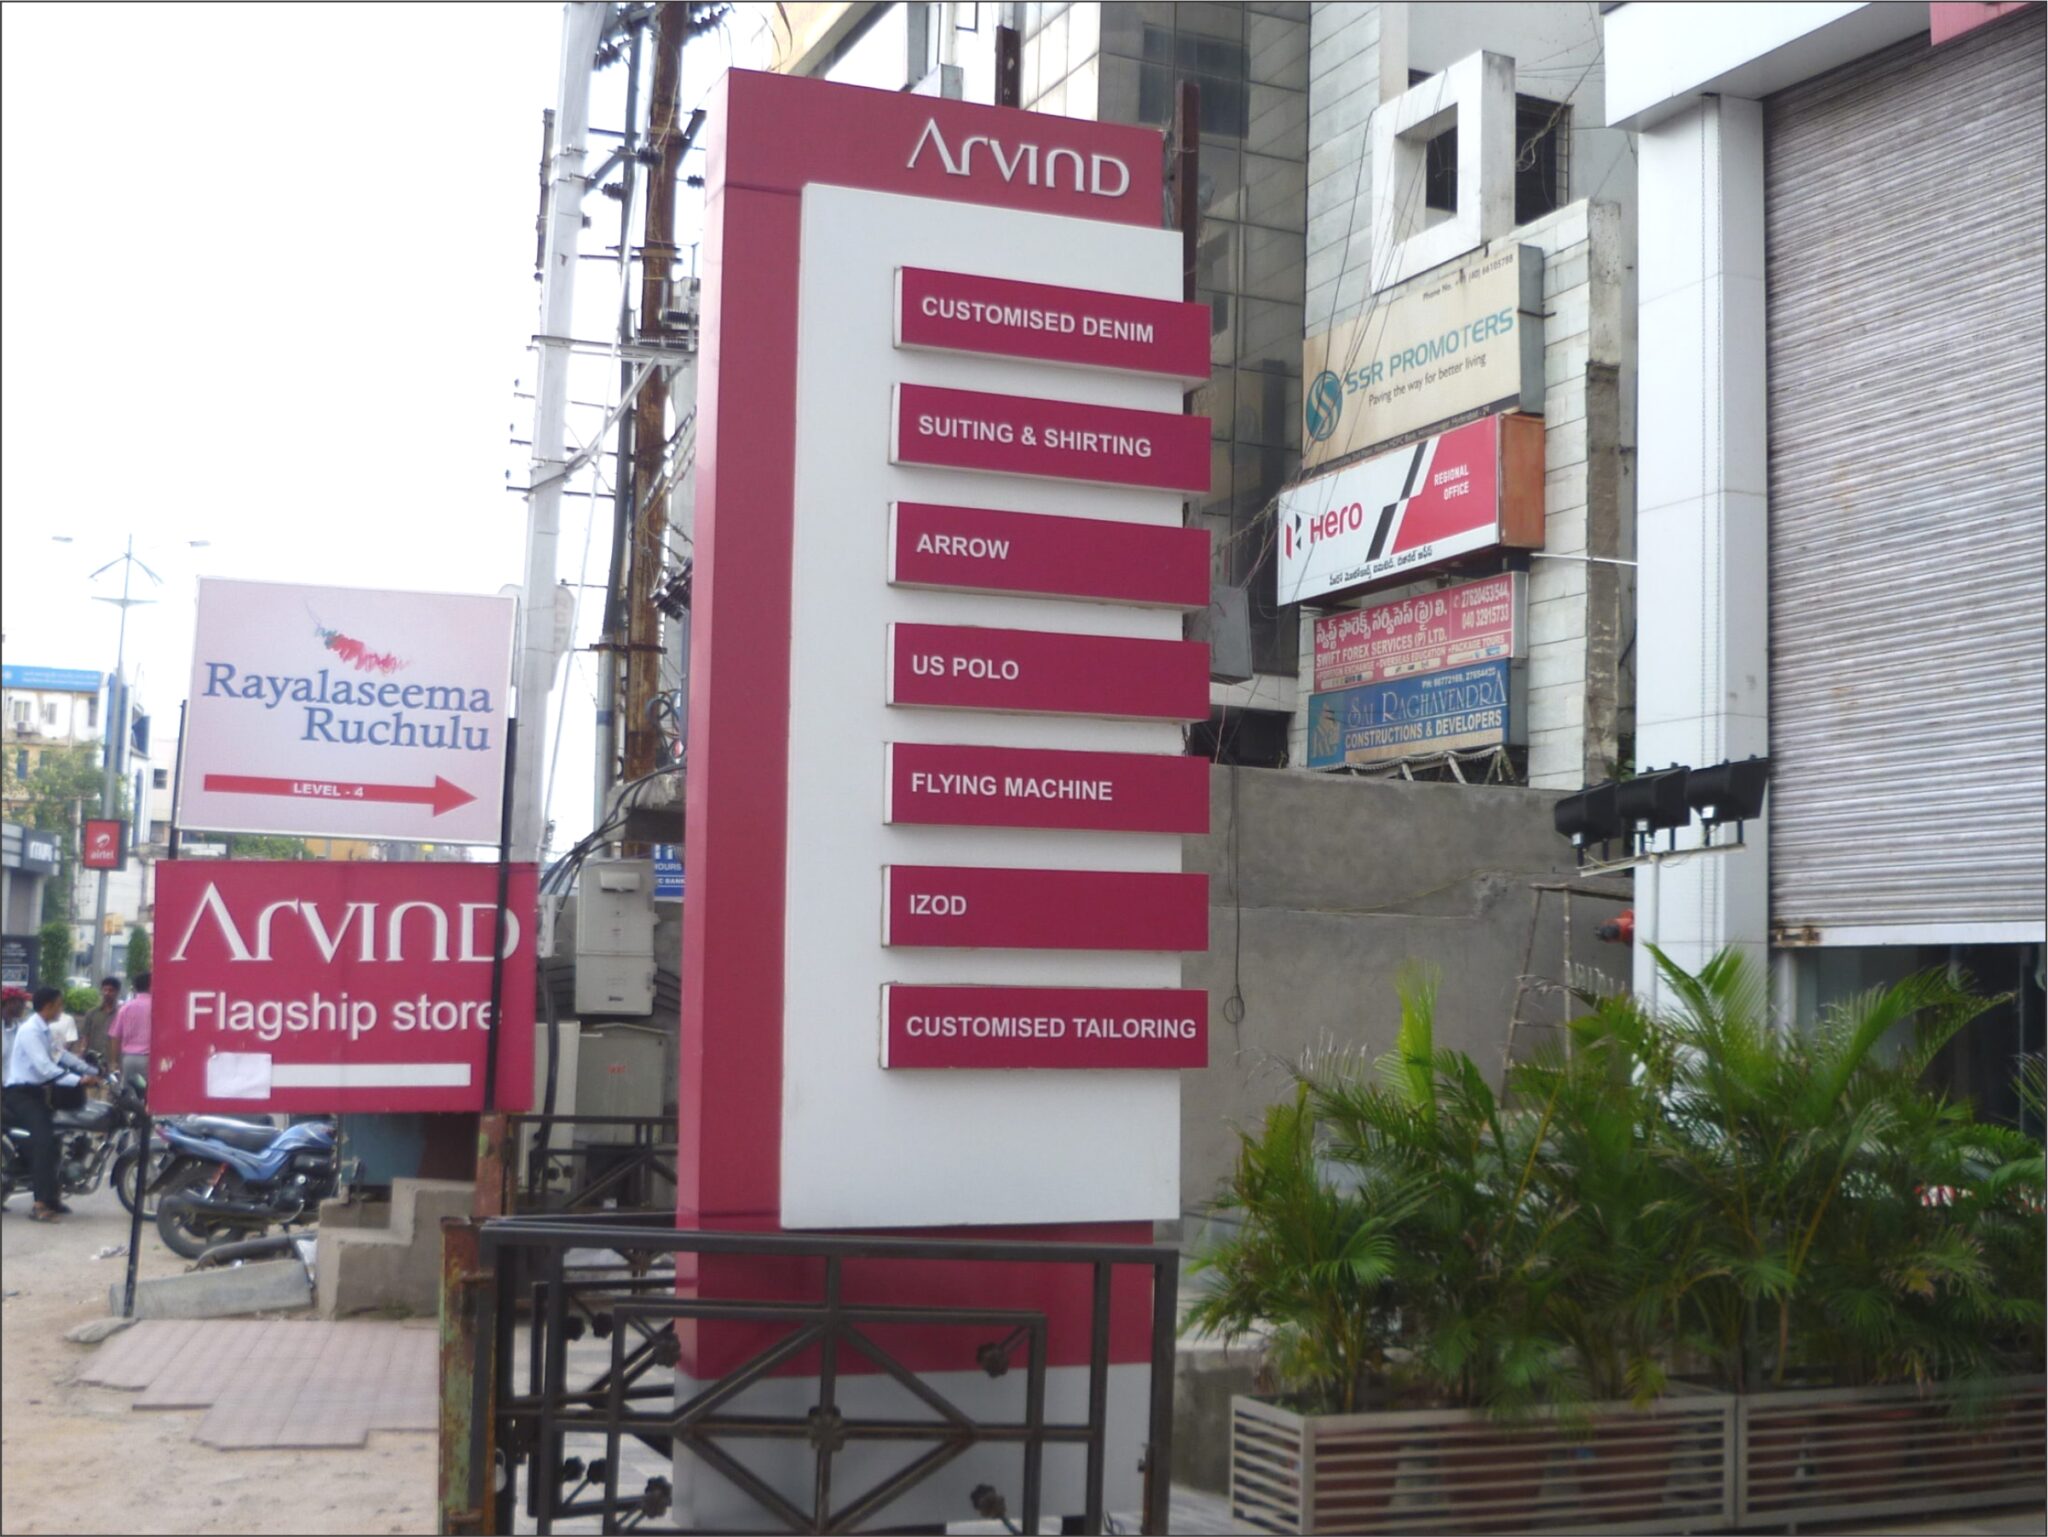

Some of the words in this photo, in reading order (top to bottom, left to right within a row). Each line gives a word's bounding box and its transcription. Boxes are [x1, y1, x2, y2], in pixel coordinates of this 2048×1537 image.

[922, 297, 1075, 333] CUSTOMISED
[1082, 317, 1154, 343] DENIM
[1345, 361, 1384, 395] SSR
[1390, 307, 1514, 378] PROMOTERS
[1368, 390, 1392, 407] Paving
[1393, 384, 1406, 398] the
[1407, 380, 1423, 394] way
[1425, 372, 1437, 387] for
[1438, 362, 1463, 381] better
[1465, 353, 1486, 370] living
[918, 415, 1013, 443] SUITING
[1020, 426, 1037, 447] &
[1043, 428, 1152, 458] SHIRTING
[1434, 464, 1469, 486] REGIONAL
[1443, 481, 1469, 500] OFFICE
[916, 533, 1009, 559] ARROW
[1316, 650, 1341, 668] SWIFT
[1343, 645, 1369, 661] FOREX
[1371, 635, 1413, 656] SERVICES
[1428, 627, 1448, 645] LTD.
[912, 655, 945, 677] US
[952, 657, 1019, 680] POLO
[202, 662, 494, 713] Rayalaseema
[300, 706, 491, 752] Ruchulu
[1345, 723, 1423, 749] CONSTRUCTIONS
[1425, 722, 1433, 737] &
[1436, 709, 1502, 736] DEVELOPERS
[293, 782, 341, 798] LEVEL
[354, 786, 364, 798] 4
[911, 772, 997, 796] FLYING
[1004, 777, 1113, 801] MACHINE
[90, 850, 114, 860] airtel
[909, 894, 967, 916] IZOD
[187, 991, 377, 1041] Flagship
[393, 993, 502, 1031] store
[906, 1016, 1066, 1039] CUSTOMISED
[1072, 1018, 1197, 1039] TAILORING
